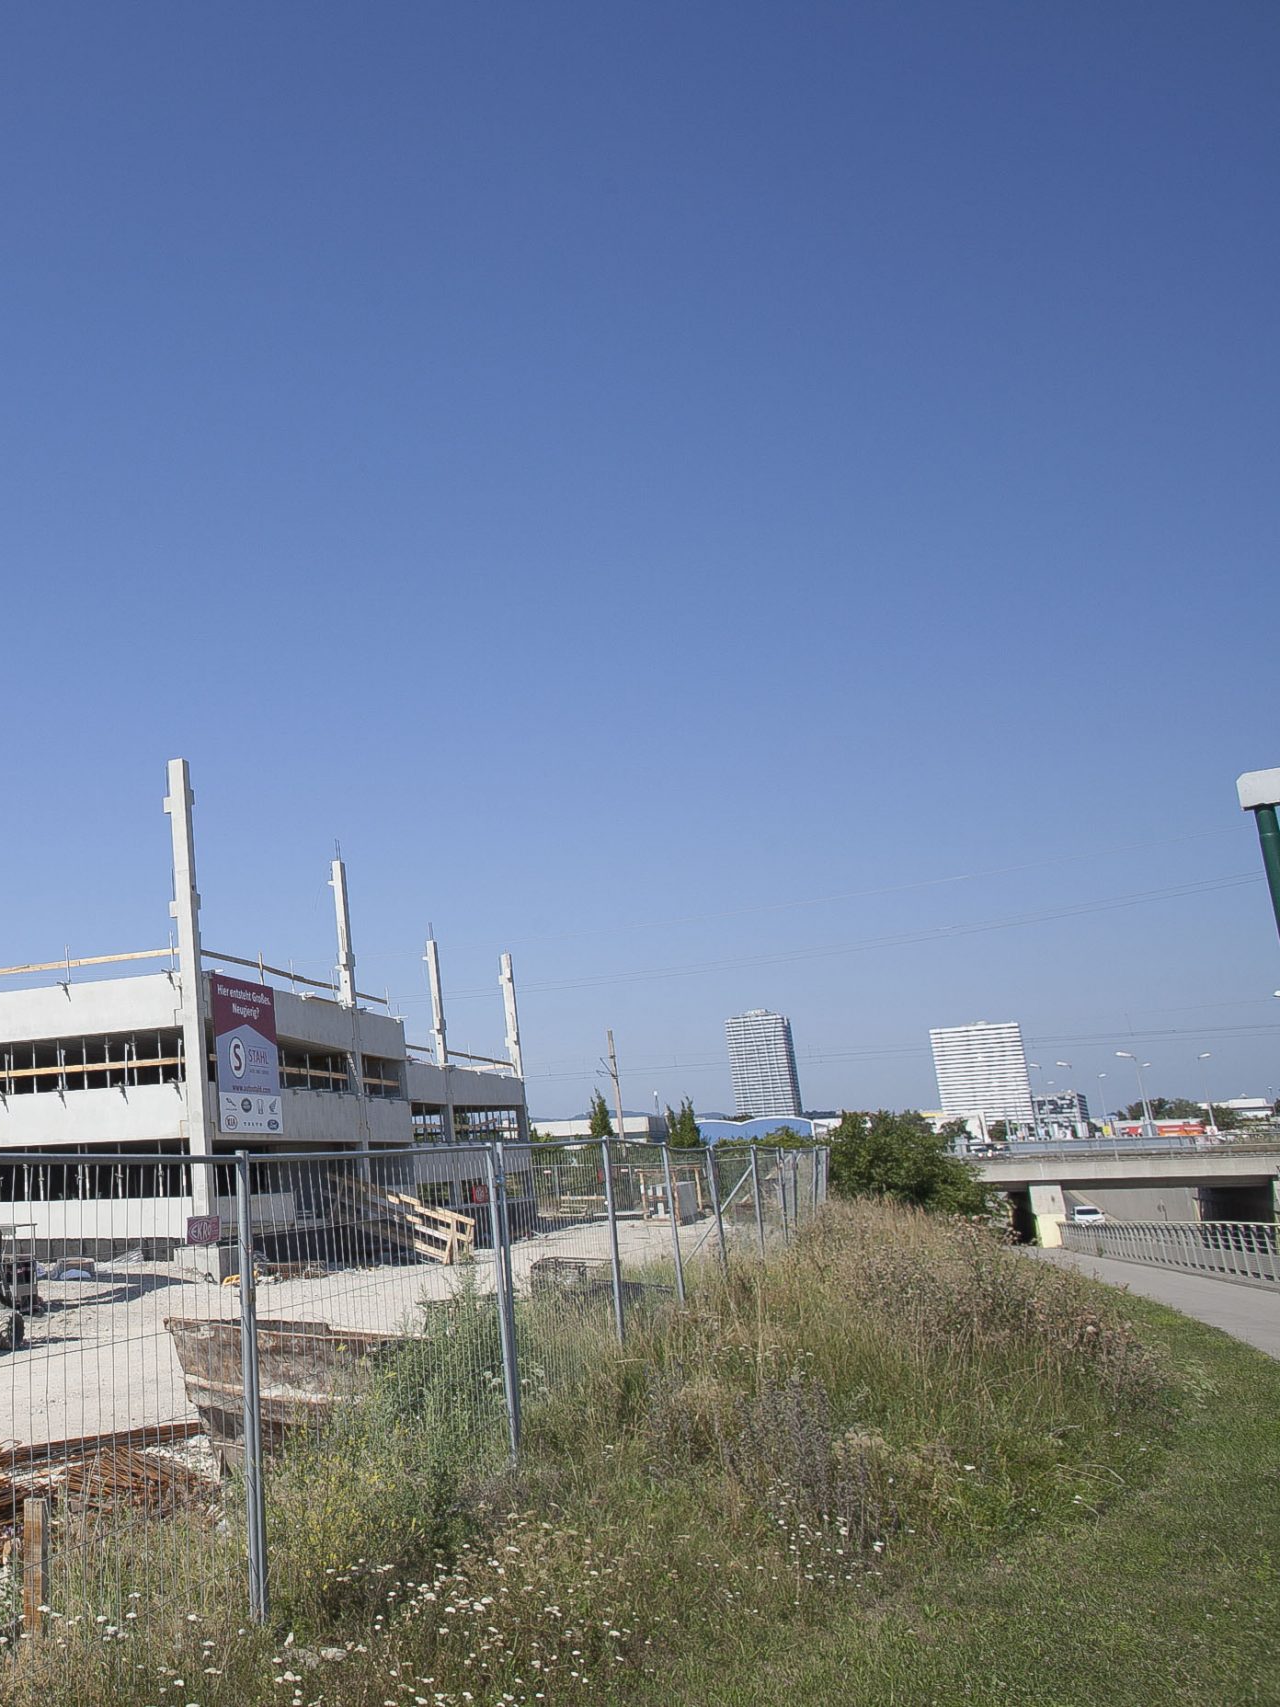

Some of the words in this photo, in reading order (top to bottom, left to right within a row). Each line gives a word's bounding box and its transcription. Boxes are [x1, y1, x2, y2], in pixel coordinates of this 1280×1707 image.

[217, 983, 229, 997] Hier
[229, 988, 252, 1003] entsteht
[232, 1003, 259, 1019] Neugierig?
[233, 1044, 242, 1071] S
[248, 1049, 269, 1065] STAHL
